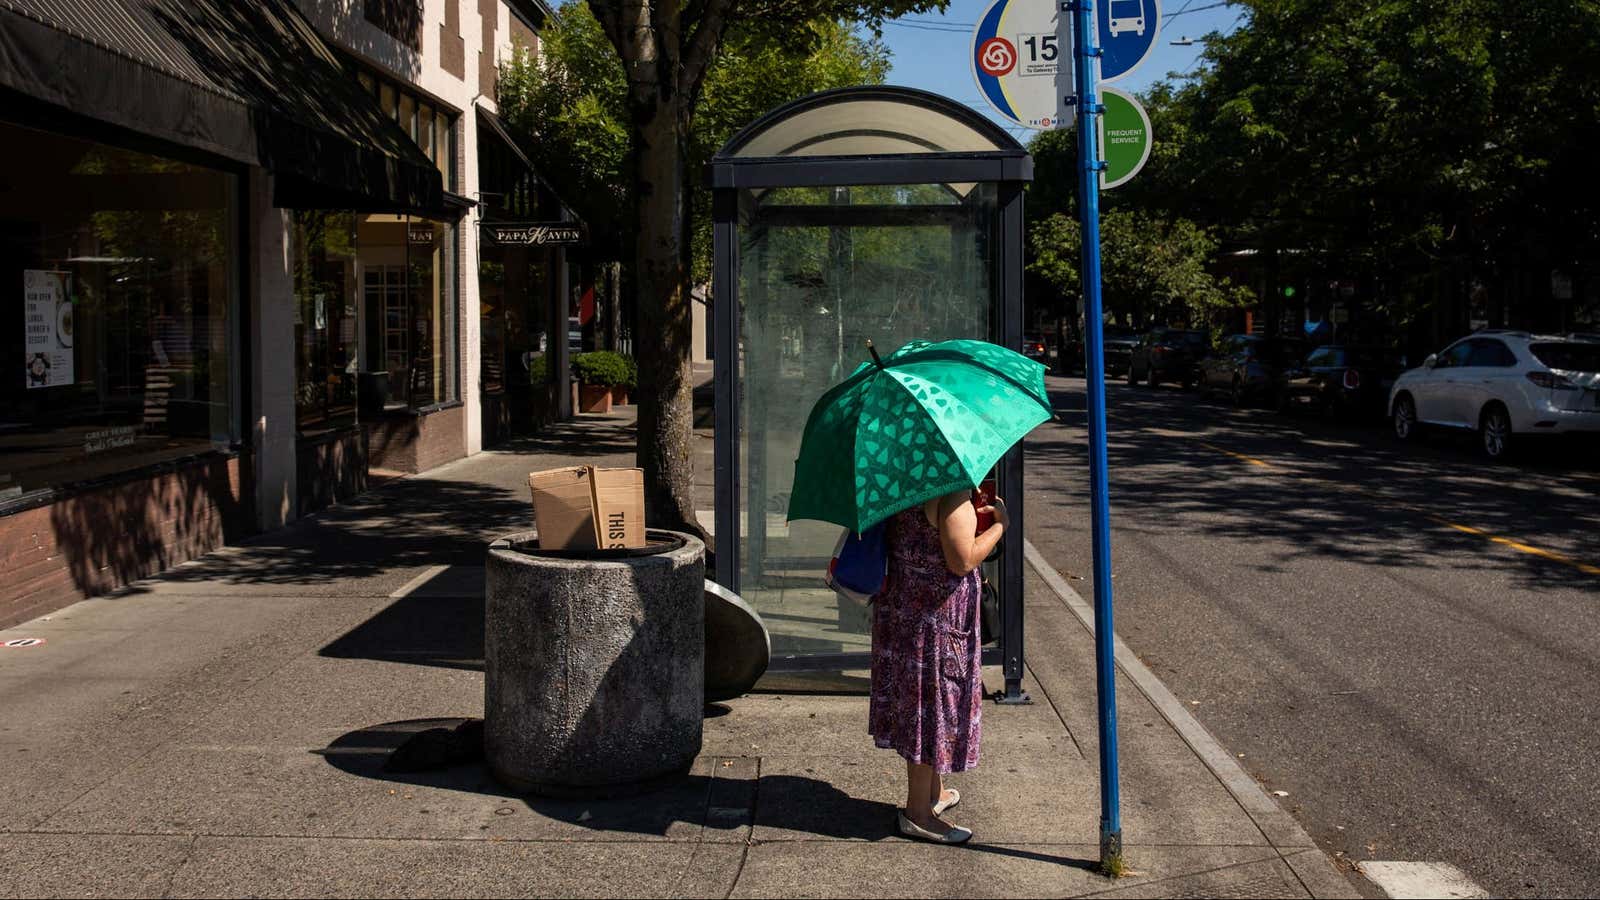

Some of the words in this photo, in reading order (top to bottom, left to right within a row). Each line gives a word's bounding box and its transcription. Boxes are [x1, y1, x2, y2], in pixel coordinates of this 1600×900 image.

[1024, 36, 1058, 61] 15
[498, 232, 528, 241] PAPA
[524, 226, 580, 244] HAYDN
[608, 511, 625, 539] THIS
